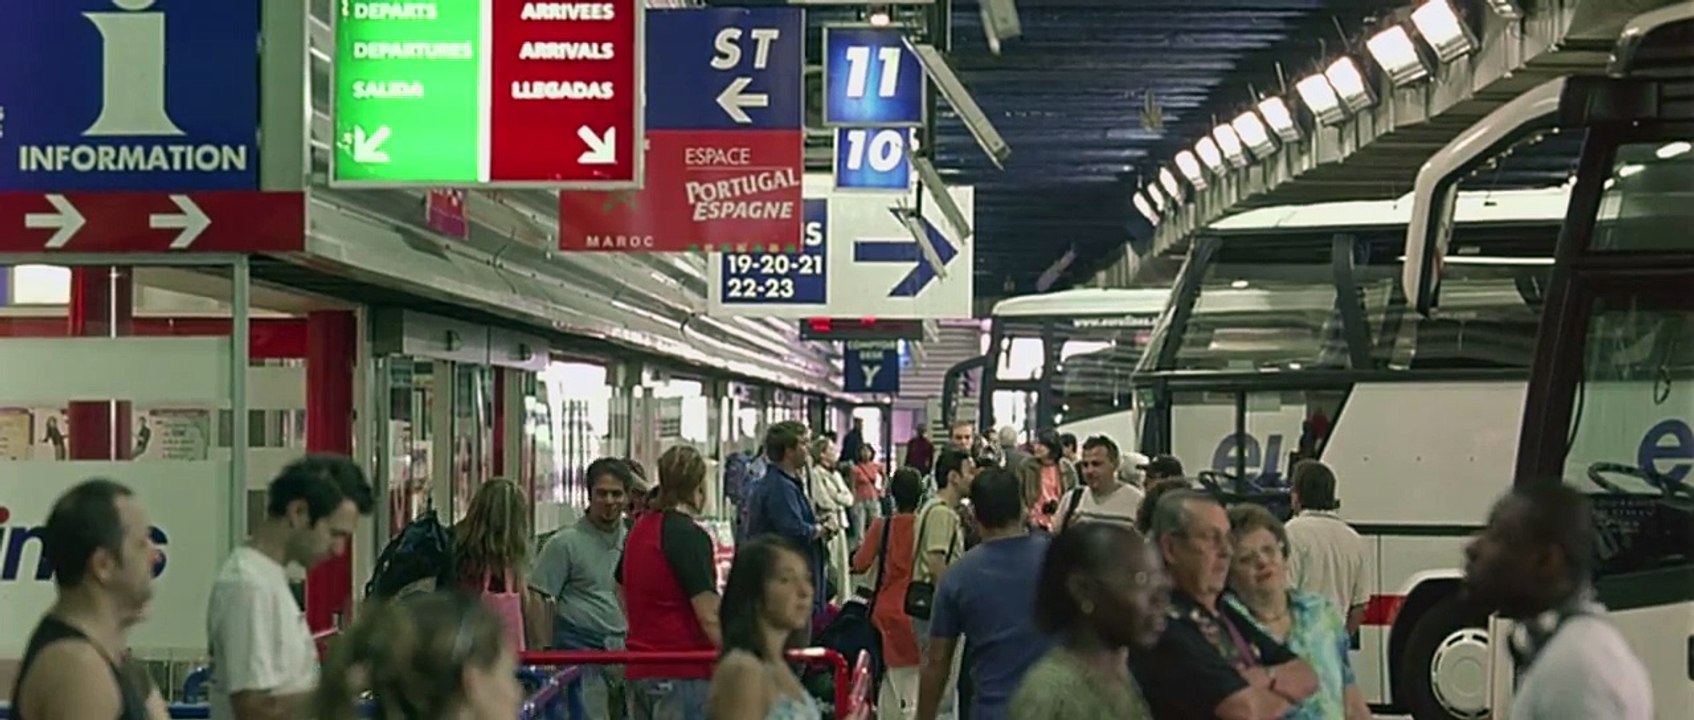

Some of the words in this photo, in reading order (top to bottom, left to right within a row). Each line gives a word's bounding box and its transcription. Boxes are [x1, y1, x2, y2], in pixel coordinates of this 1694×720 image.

[354, 2, 437, 20] DEPARTS
[353, 41, 472, 60] DEPARTURES
[519, 41, 615, 60] ARRIVALS
[846, 45, 901, 98] 11
[352, 80, 425, 99] SALIDA
[511, 81, 615, 99] LLEGADAS
[19, 144, 247, 172] INFORMATION
[685, 148, 751, 165] ESPACE
[847, 129, 904, 172] 10
[685, 168, 800, 205] PORTUGAL
[692, 201, 794, 222] ESPAGNE
[585, 235, 655, 248] MAROC
[727, 254, 823, 275] 19-20-21
[727, 278, 795, 299] 22-23
[861, 365, 882, 388] Y
